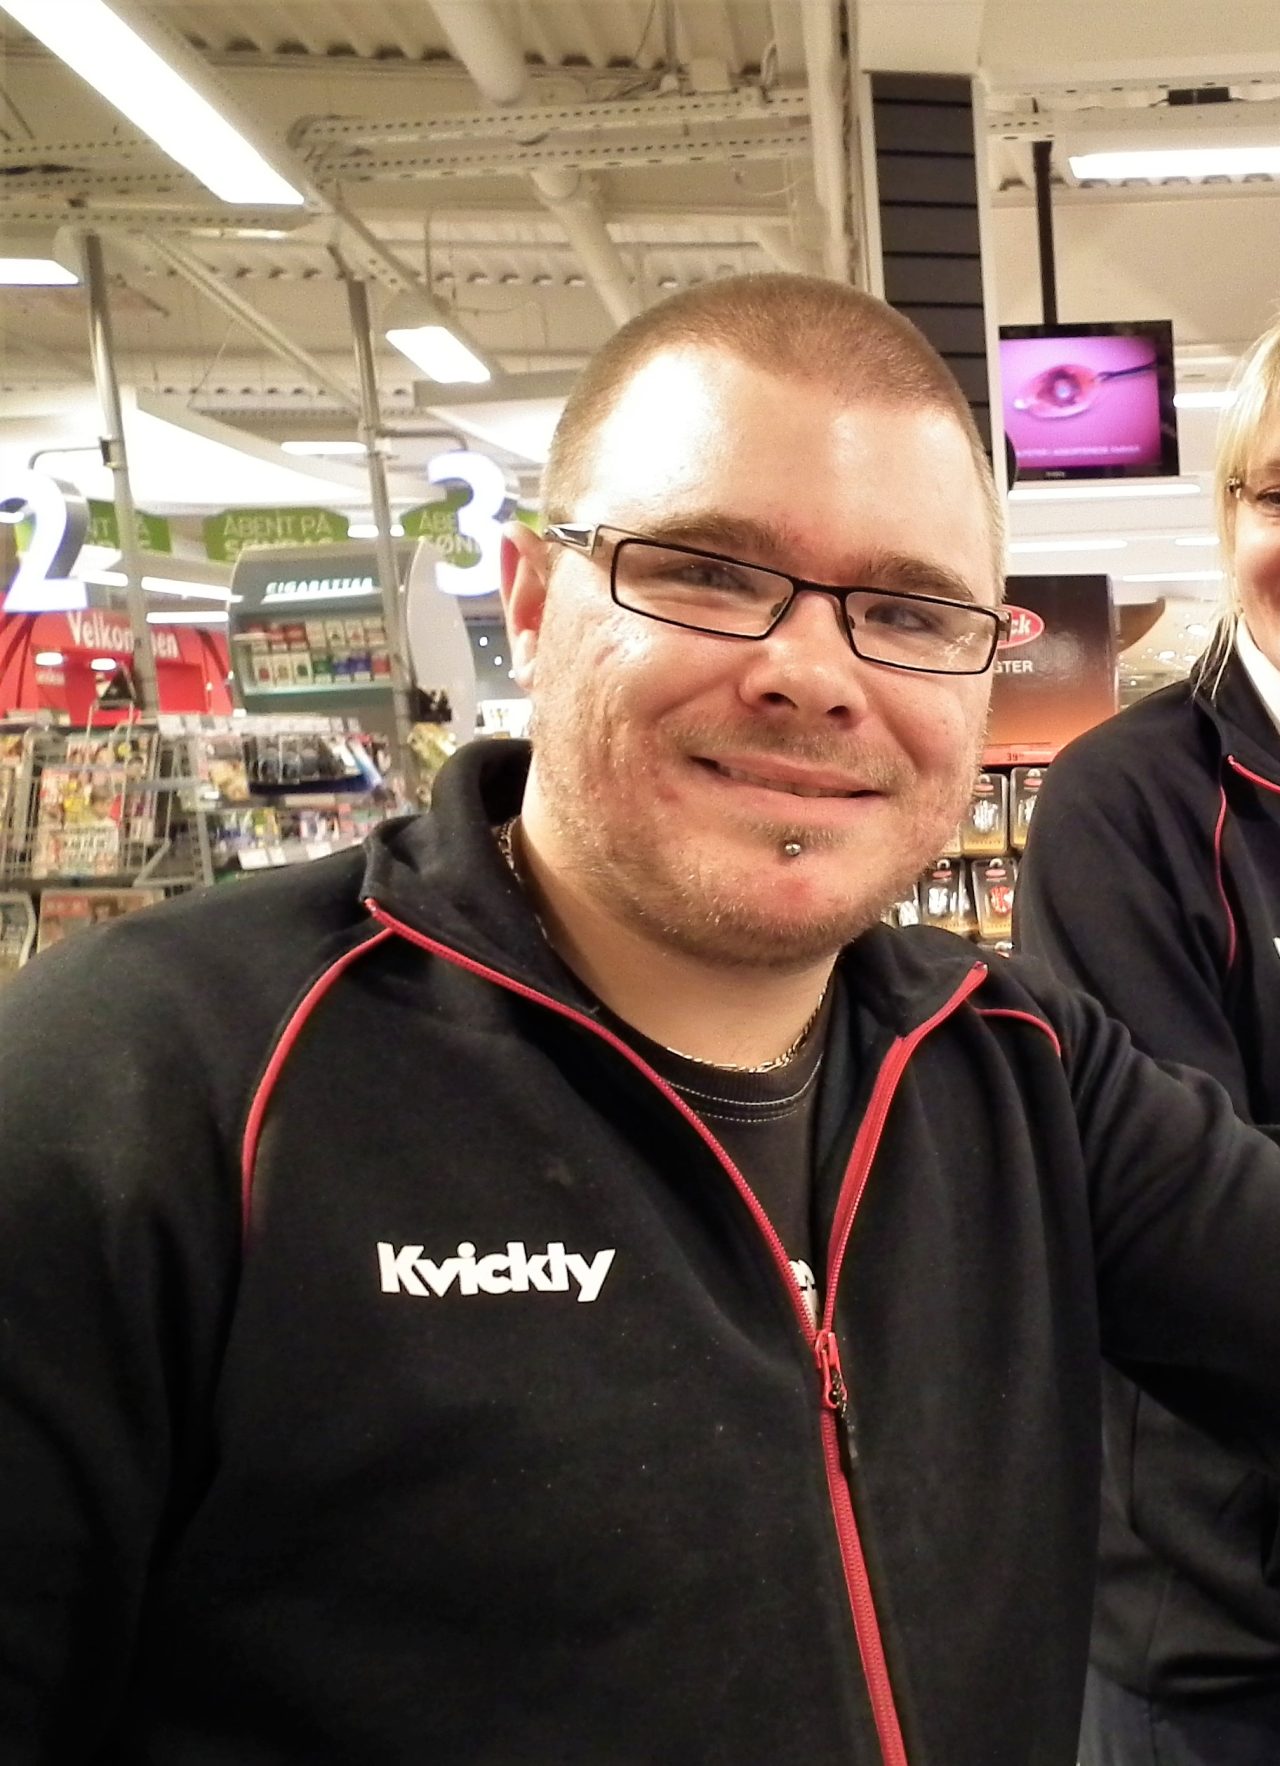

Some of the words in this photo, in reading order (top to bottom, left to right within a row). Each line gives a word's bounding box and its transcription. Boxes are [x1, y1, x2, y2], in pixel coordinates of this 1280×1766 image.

[0, 470, 88, 614] 2
[428, 450, 505, 597] 3
[66, 610, 181, 660] Velkoen
